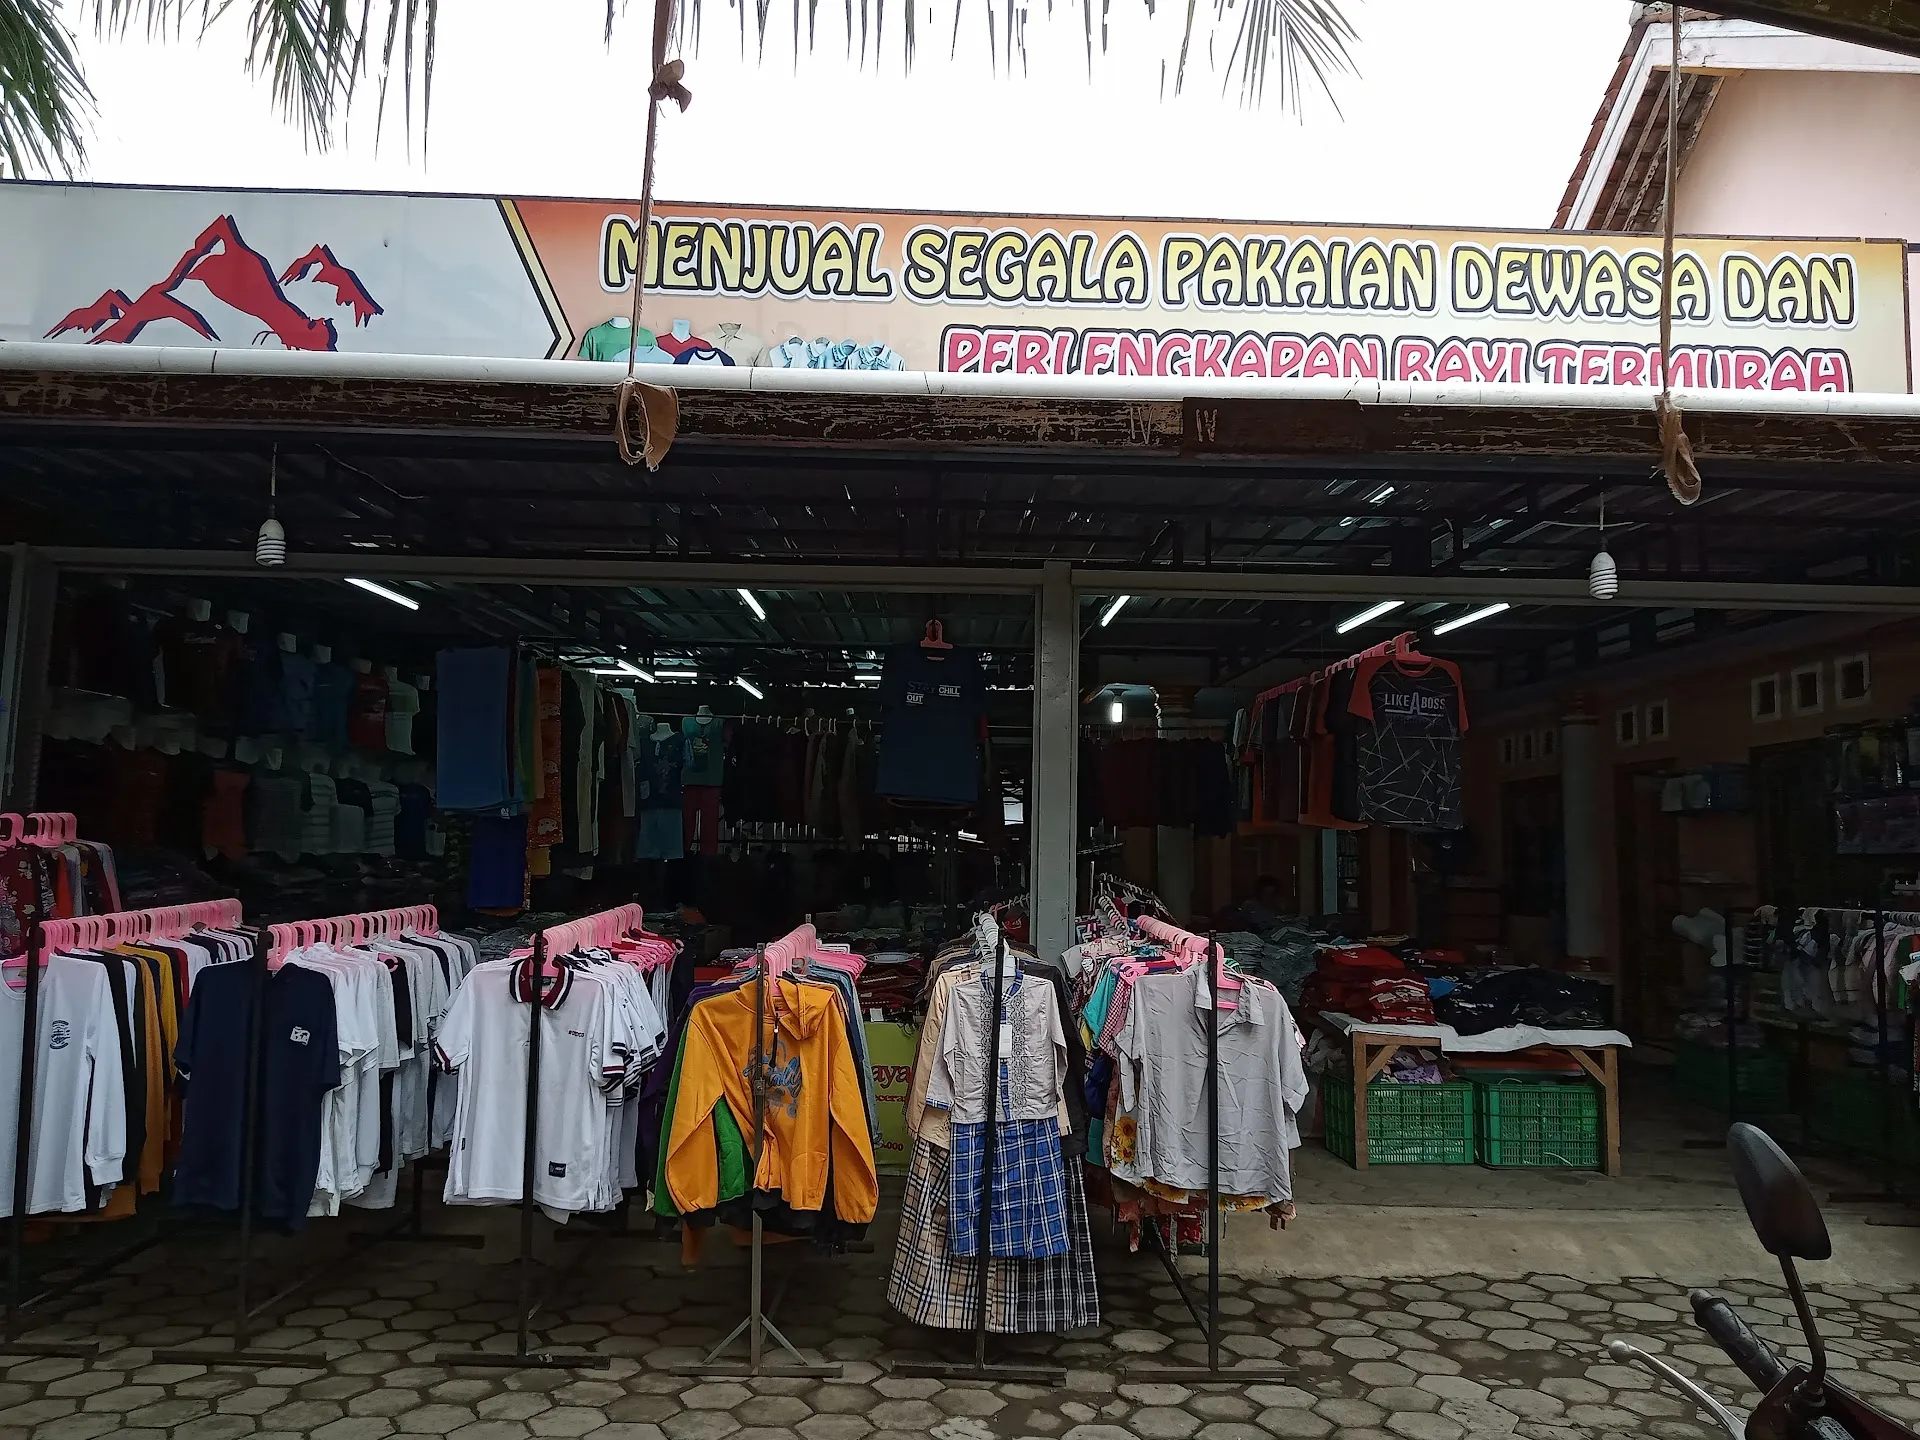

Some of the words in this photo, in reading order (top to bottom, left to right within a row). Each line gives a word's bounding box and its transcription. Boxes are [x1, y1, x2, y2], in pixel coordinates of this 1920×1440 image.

[604, 219, 893, 296] MENJUAL
[904, 228, 1150, 303] SEGALA
[1162, 236, 1437, 309] PAKAIAN
[1452, 246, 1711, 319] DEWASA
[1724, 252, 1854, 325] DAN
[905, 693, 924, 703] OUT
[938, 686, 960, 696] CHILL
[1384, 693, 1411, 707] LIKE
[1410, 692, 1421, 715] A
[1420, 696, 1446, 710] BOSS
